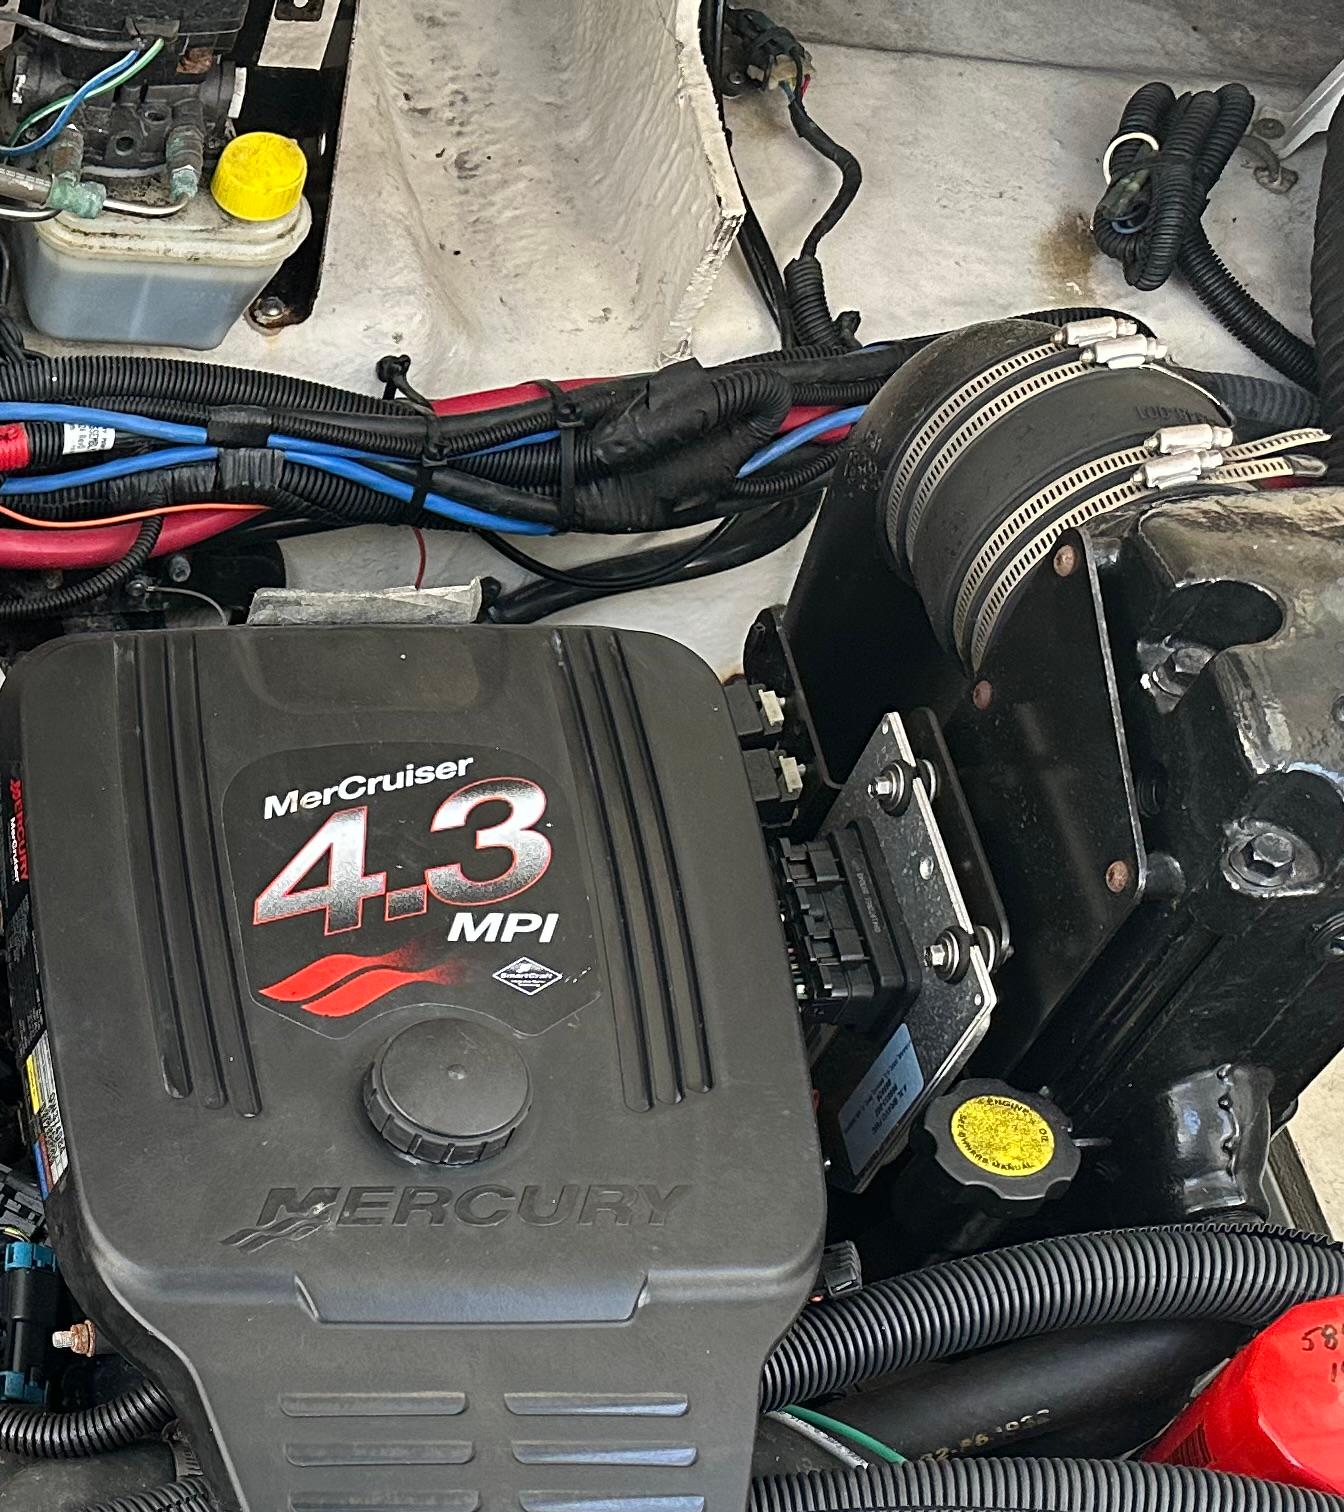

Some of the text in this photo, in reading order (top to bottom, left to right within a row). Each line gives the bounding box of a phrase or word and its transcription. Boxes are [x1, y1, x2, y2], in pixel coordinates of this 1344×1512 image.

[263, 757, 474, 821] MerCruiser
[253, 776, 553, 936] 4.3
[447, 912, 560, 943] MPI
[255, 1184, 691, 1228] MERCURY
[1302, 1323, 1344, 1352] 58
